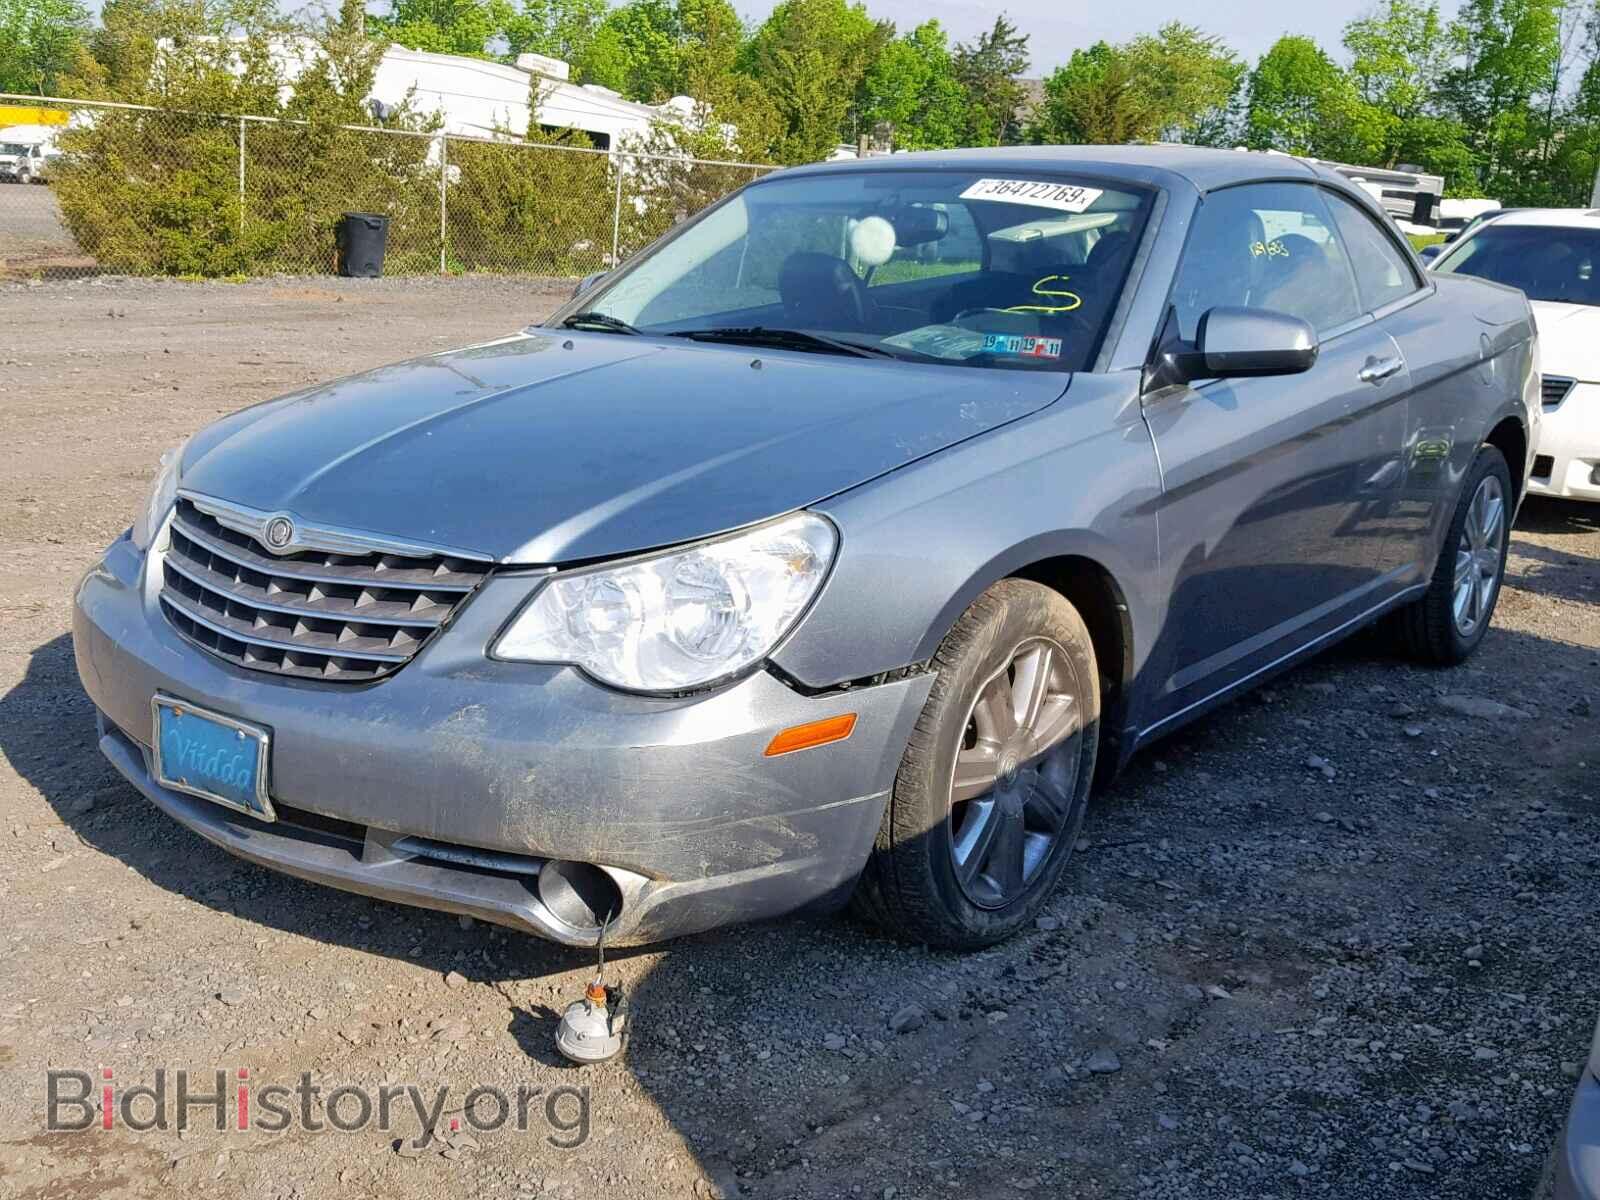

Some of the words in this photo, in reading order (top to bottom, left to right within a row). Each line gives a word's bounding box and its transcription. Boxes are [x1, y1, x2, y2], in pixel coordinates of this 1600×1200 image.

[983, 335, 996, 348] 19
[1010, 339, 1020, 351] 11
[1024, 337, 1036, 350] 19
